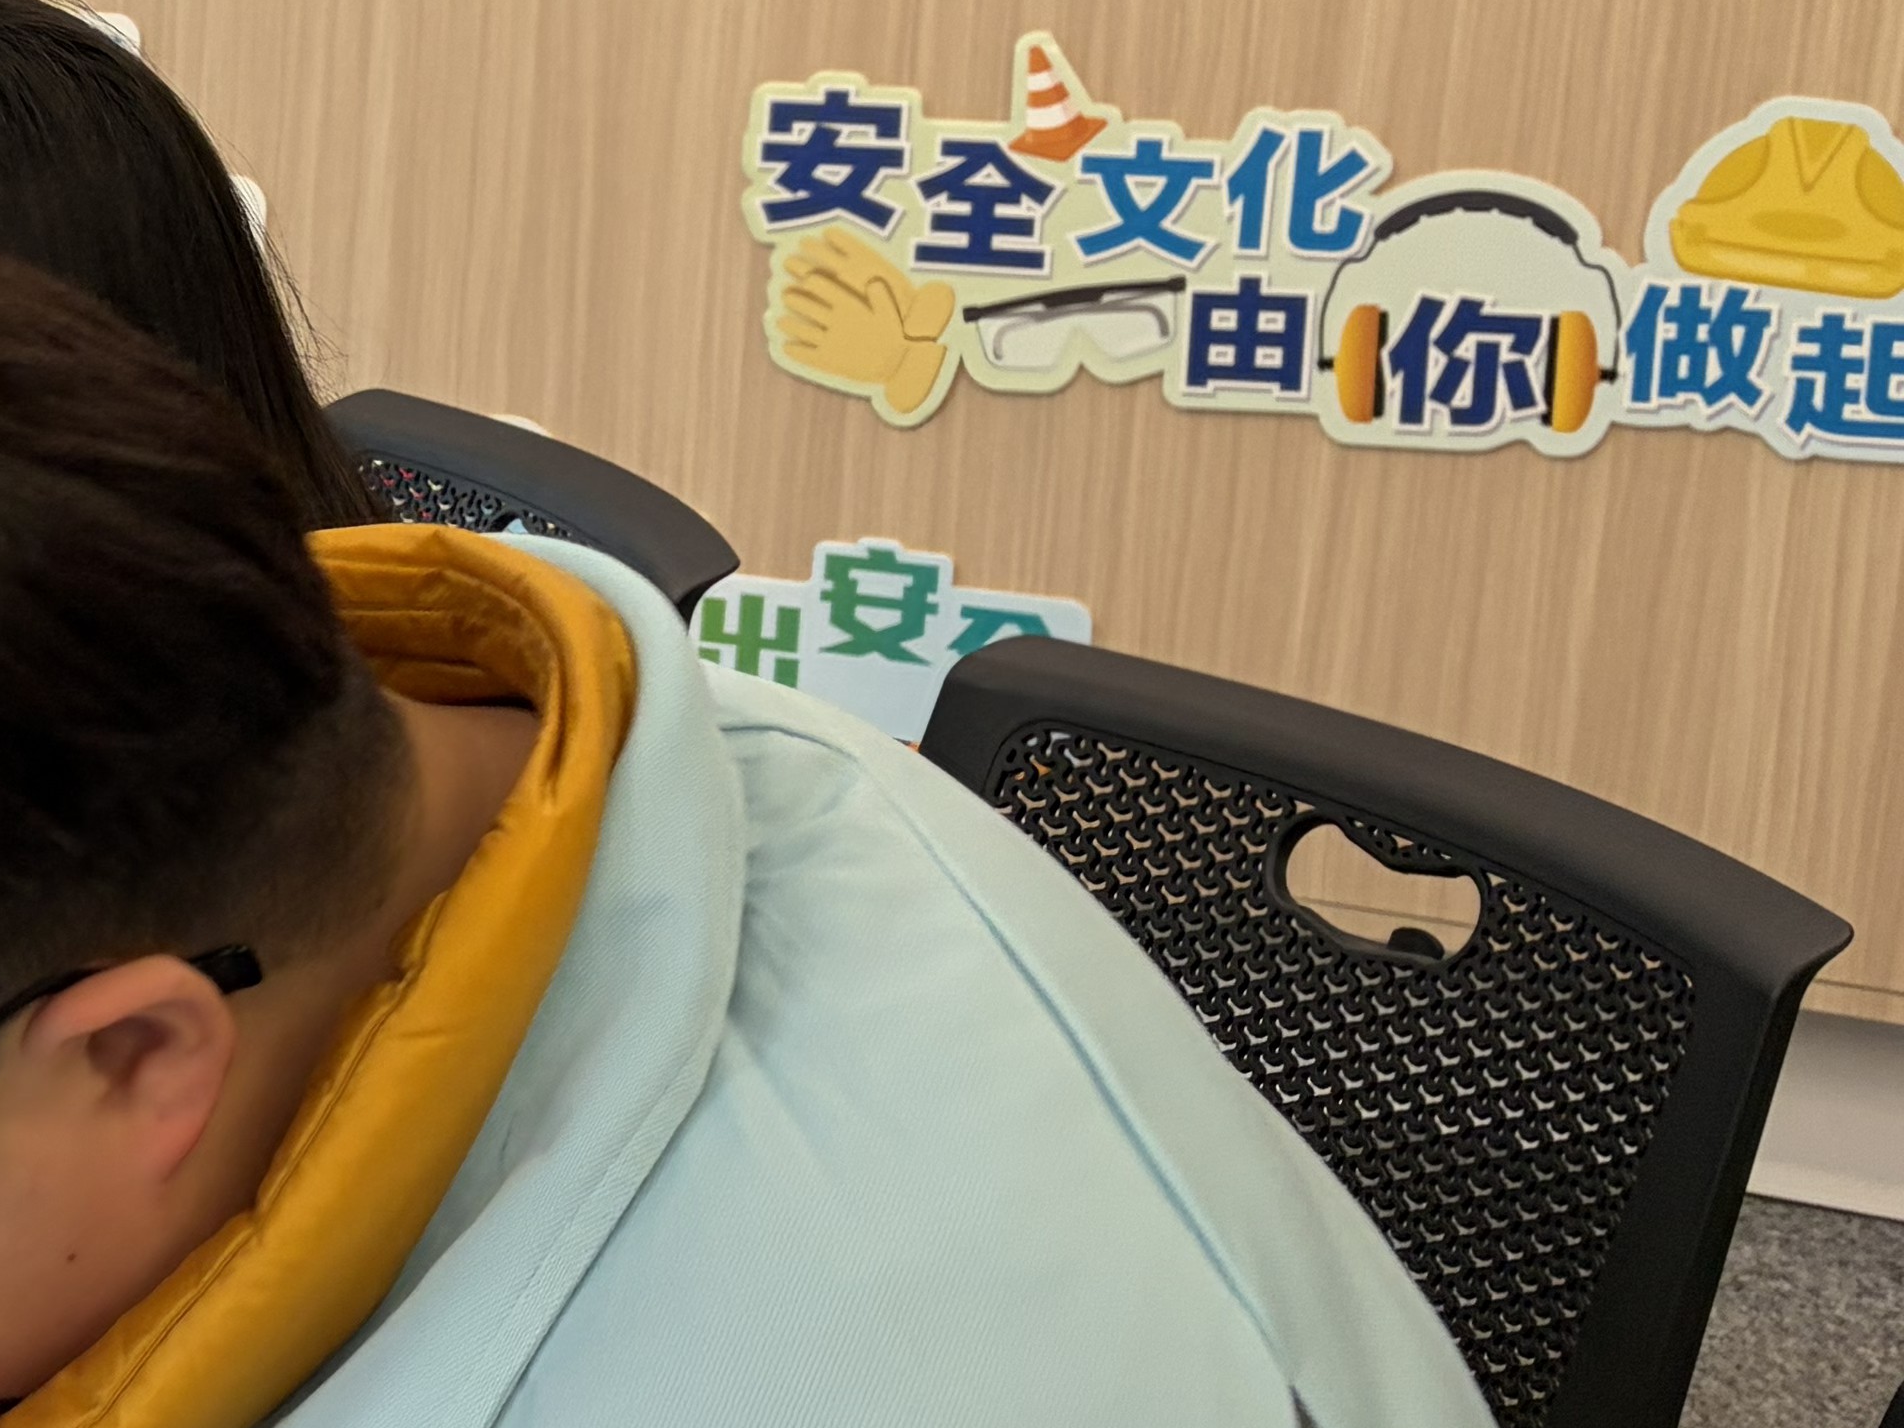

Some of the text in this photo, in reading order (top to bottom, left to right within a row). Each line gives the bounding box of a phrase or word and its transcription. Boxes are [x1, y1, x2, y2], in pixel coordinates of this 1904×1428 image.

[758, 87, 1374, 274] 安全文化
[1186, 275, 1904, 444] 由你做起
